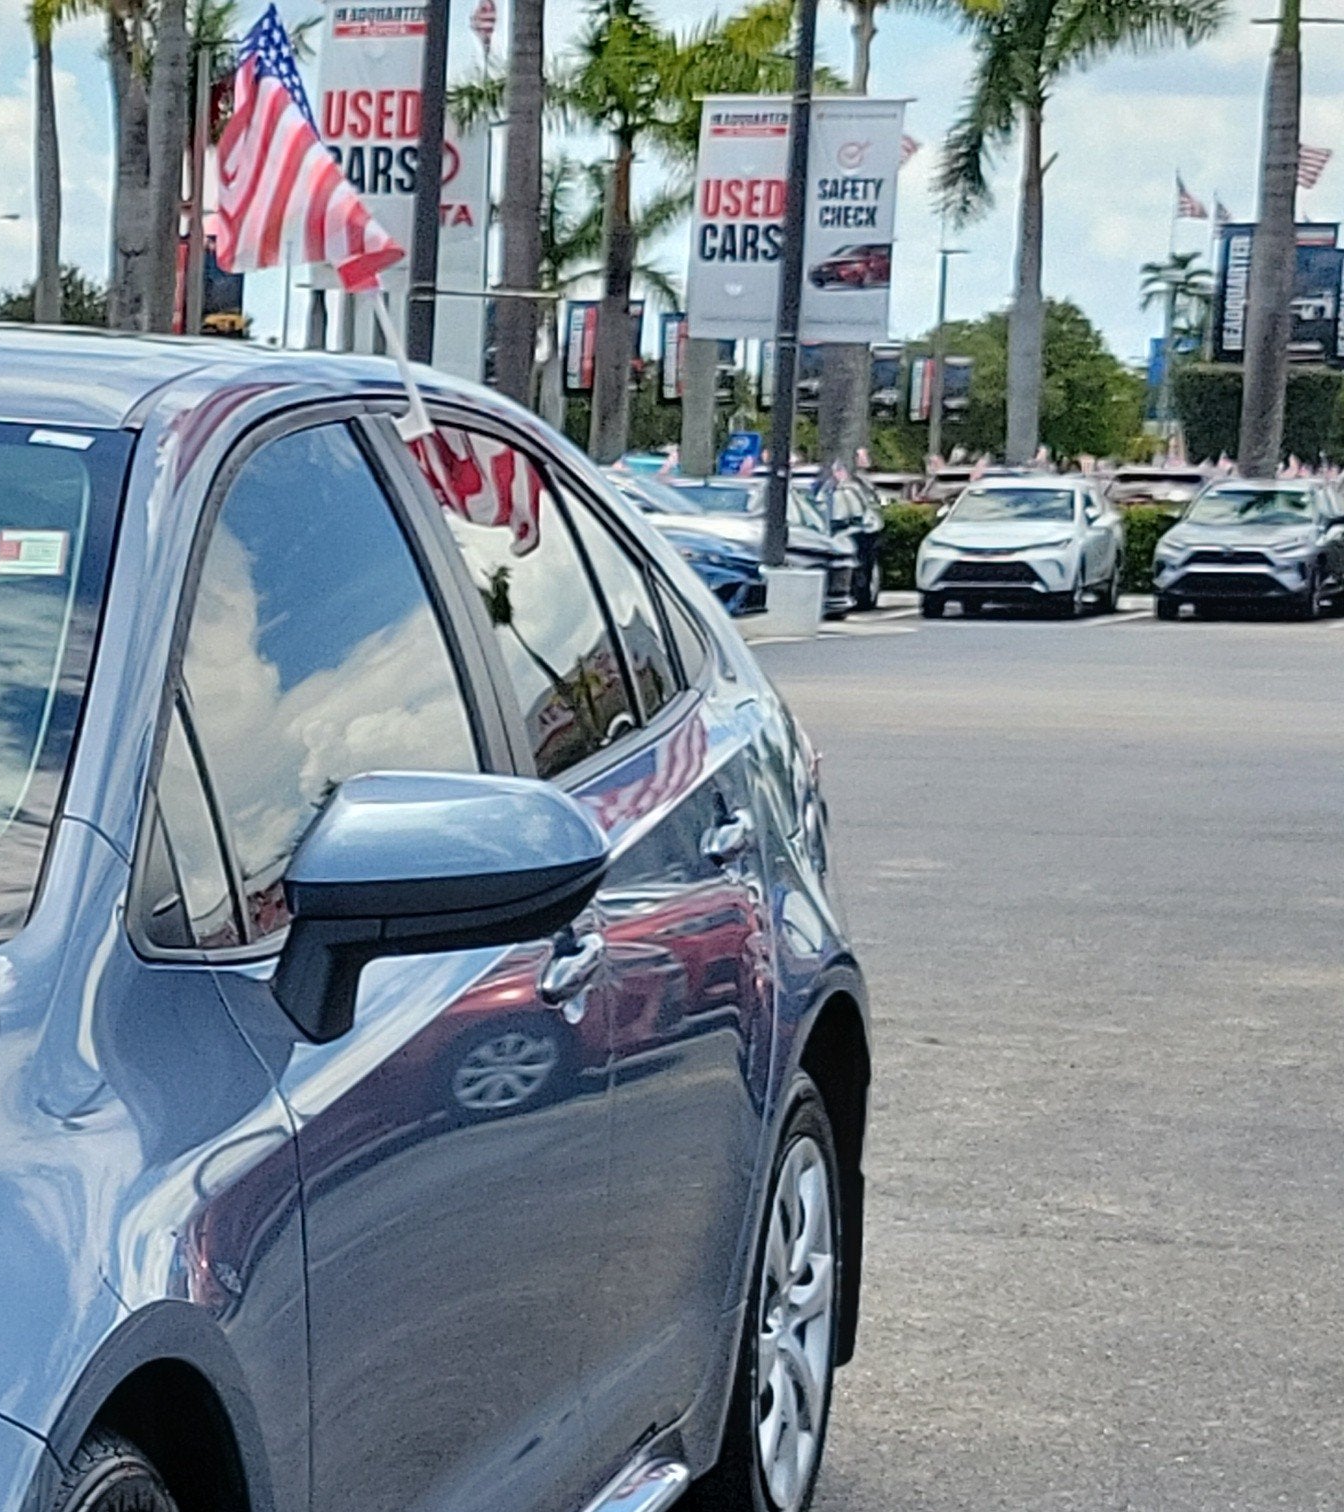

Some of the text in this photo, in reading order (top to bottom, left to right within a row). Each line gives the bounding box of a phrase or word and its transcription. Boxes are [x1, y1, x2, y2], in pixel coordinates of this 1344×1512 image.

[323, 90, 422, 139] USED
[702, 179, 788, 217] USED
[817, 178, 883, 200] SAFETY
[819, 206, 878, 228] CHECK
[700, 224, 786, 261] CARS
